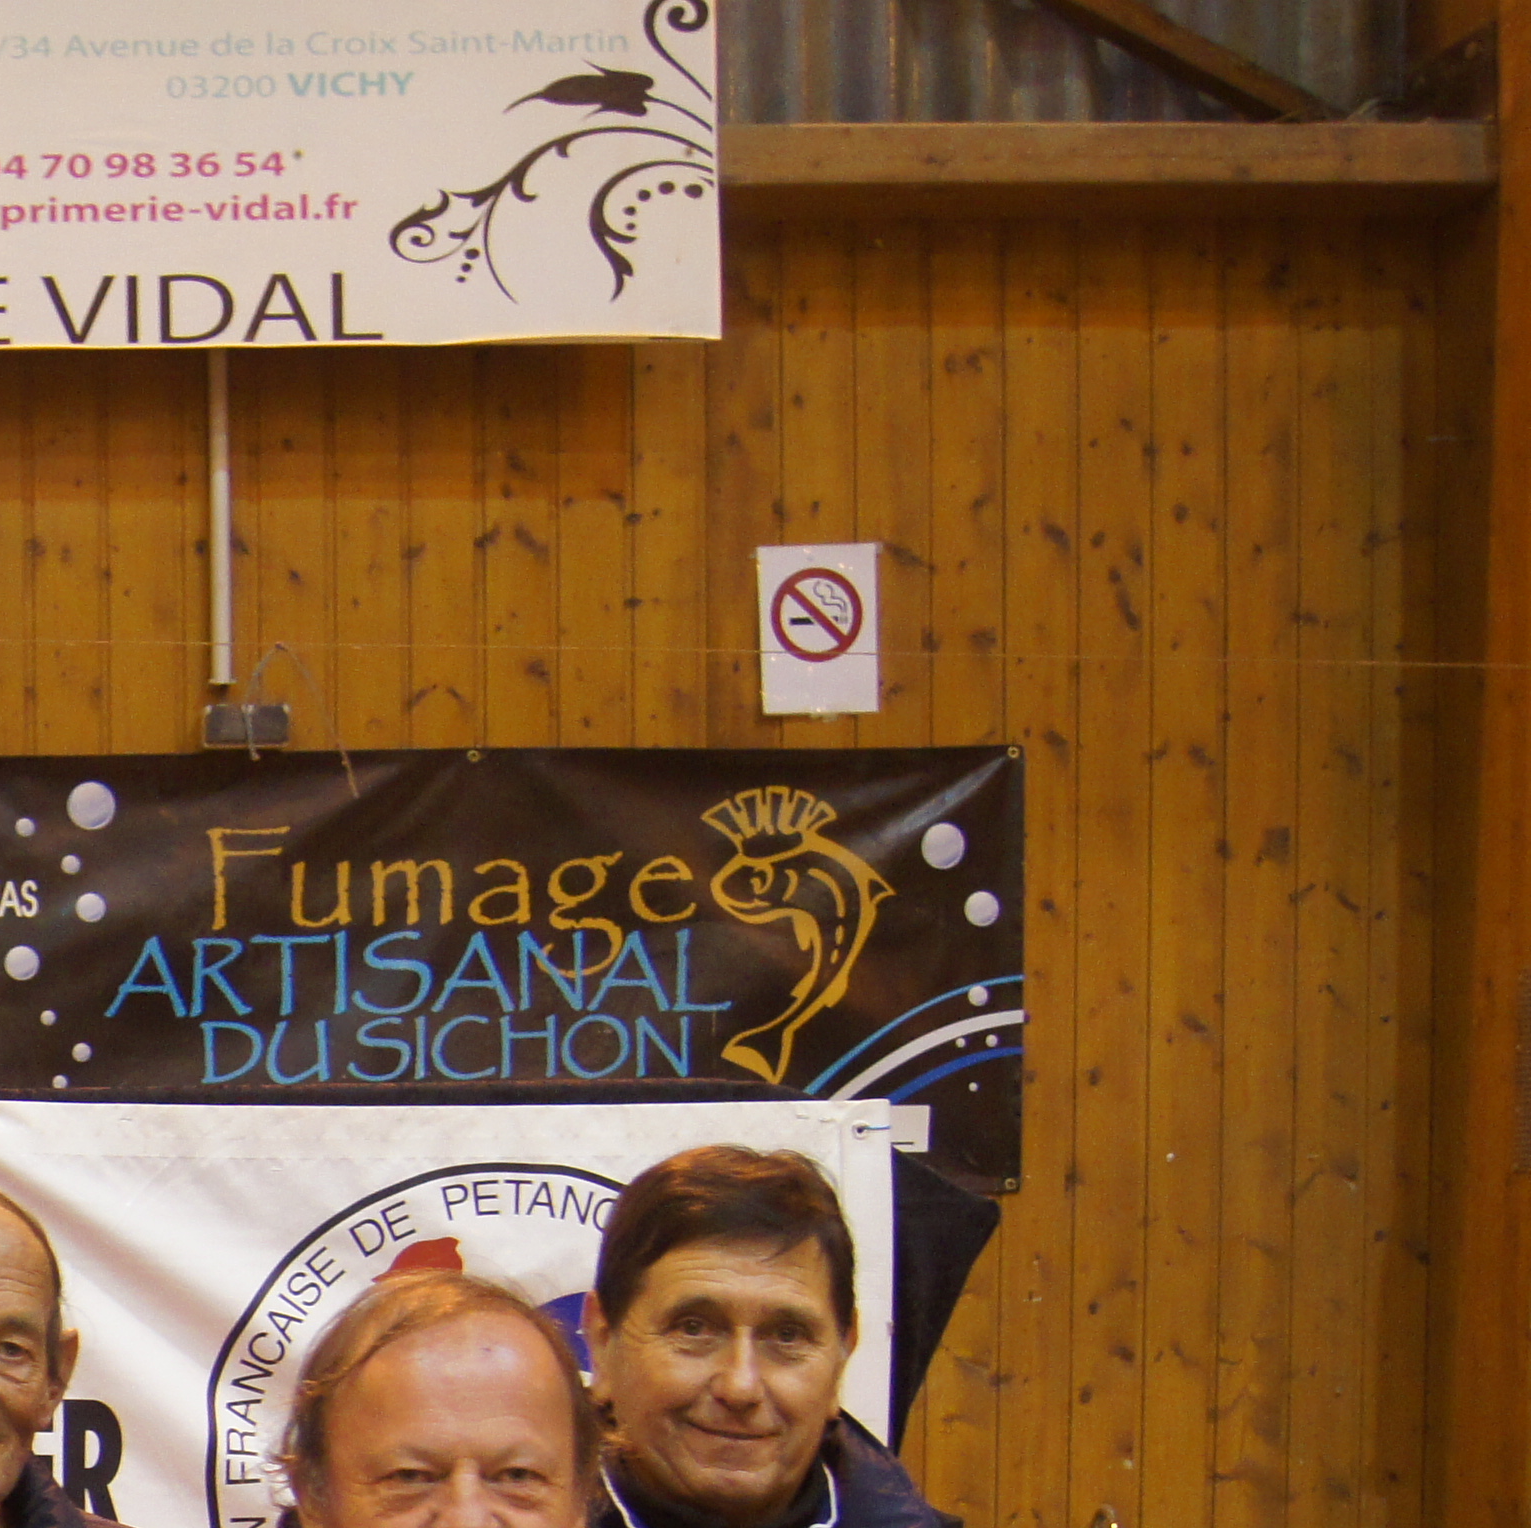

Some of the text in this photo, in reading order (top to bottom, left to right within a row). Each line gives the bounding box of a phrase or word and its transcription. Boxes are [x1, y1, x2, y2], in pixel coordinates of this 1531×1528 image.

[63, 34, 200, 58] Avenue
[209, 31, 256, 57] de
[266, 31, 296, 56] la
[305, 30, 398, 55] Croix
[407, 29, 630, 55] Saint-Martin
[165, 70, 415, 99] 03200 VICHY
[40, 152, 93, 179] 70
[103, 151, 158, 179] 98
[169, 151, 222, 178] 36
[233, 150, 286, 177] 54
[40, 271, 386, 346] VIDAL
[204, 824, 697, 978] Fumage
[103, 928, 733, 1019] ARTISANAL
[200, 1012, 691, 1086] DU SICHON
[224, 1246, 346, 1486] FRANCAISE
[348, 1200, 417, 1258] DE
